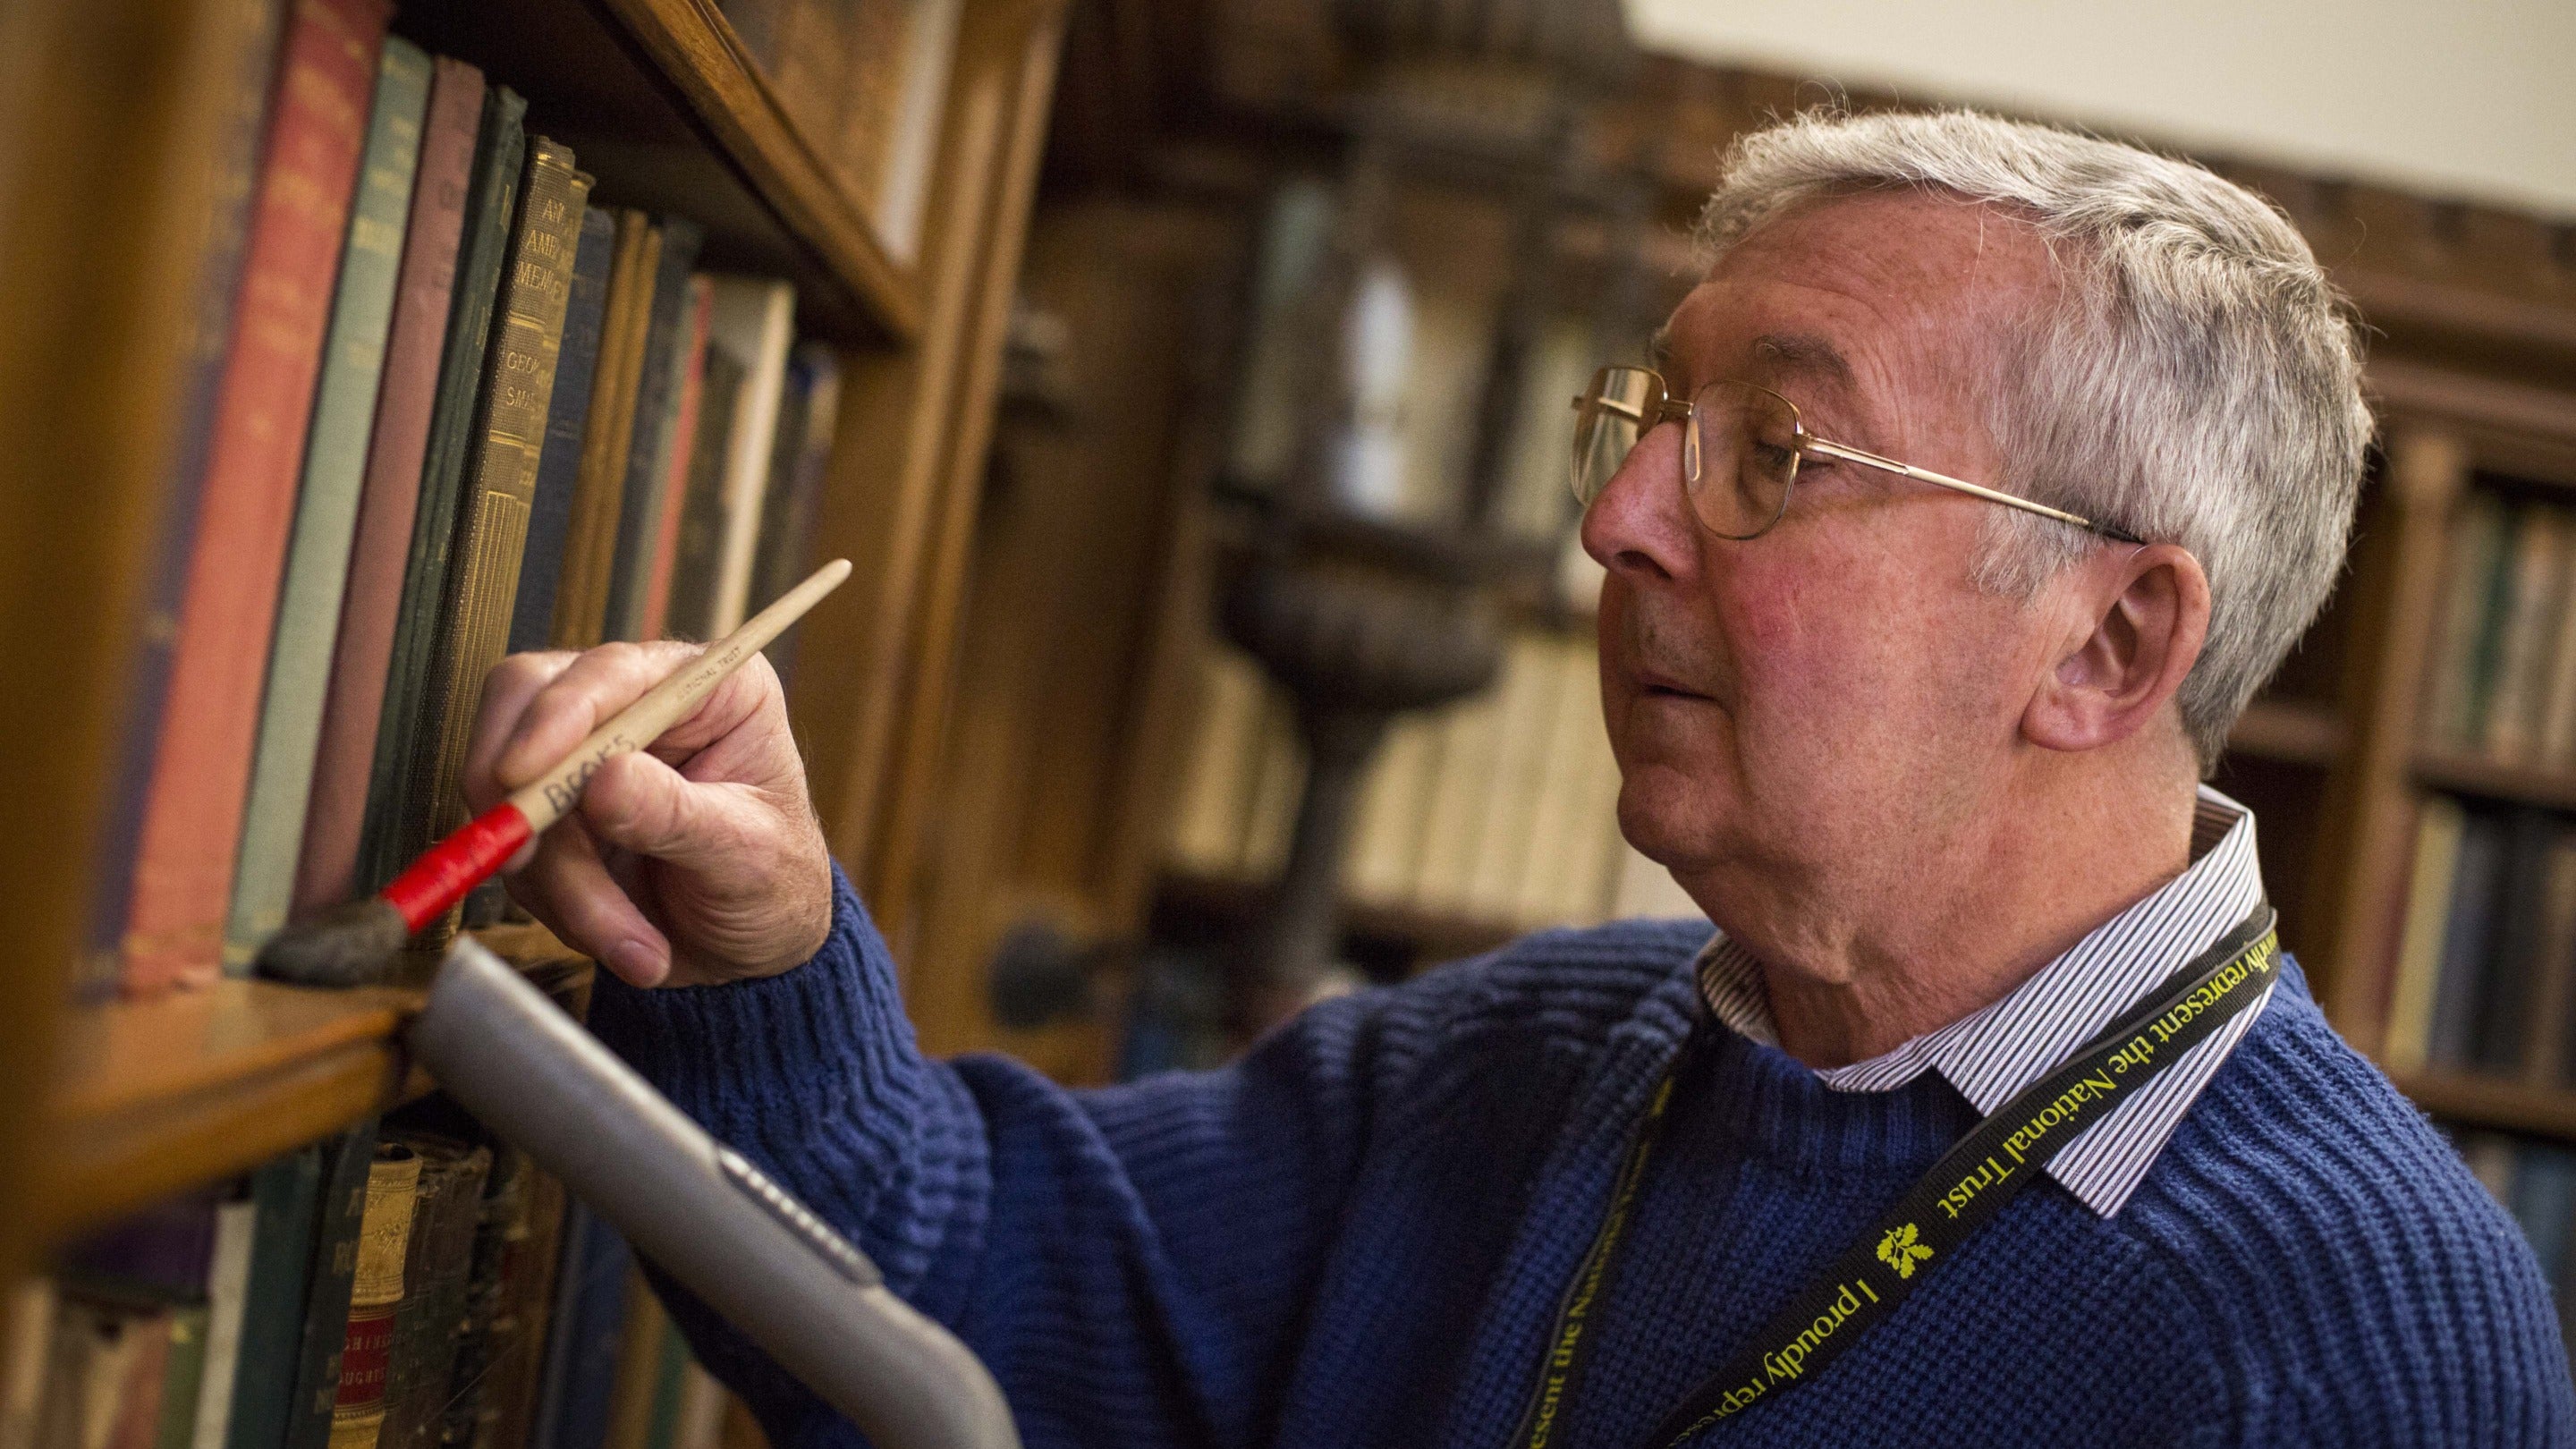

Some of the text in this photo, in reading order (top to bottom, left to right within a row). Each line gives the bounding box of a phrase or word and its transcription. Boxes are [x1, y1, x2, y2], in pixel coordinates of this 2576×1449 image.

[2148, 960, 2248, 1043] represent
[2108, 1036, 2154, 1073] the
[2003, 1068, 2117, 1164] National
[1937, 1157, 2015, 1218] Trust
[1857, 1279, 1879, 1303] I
[1764, 1285, 1861, 1385] proudly
